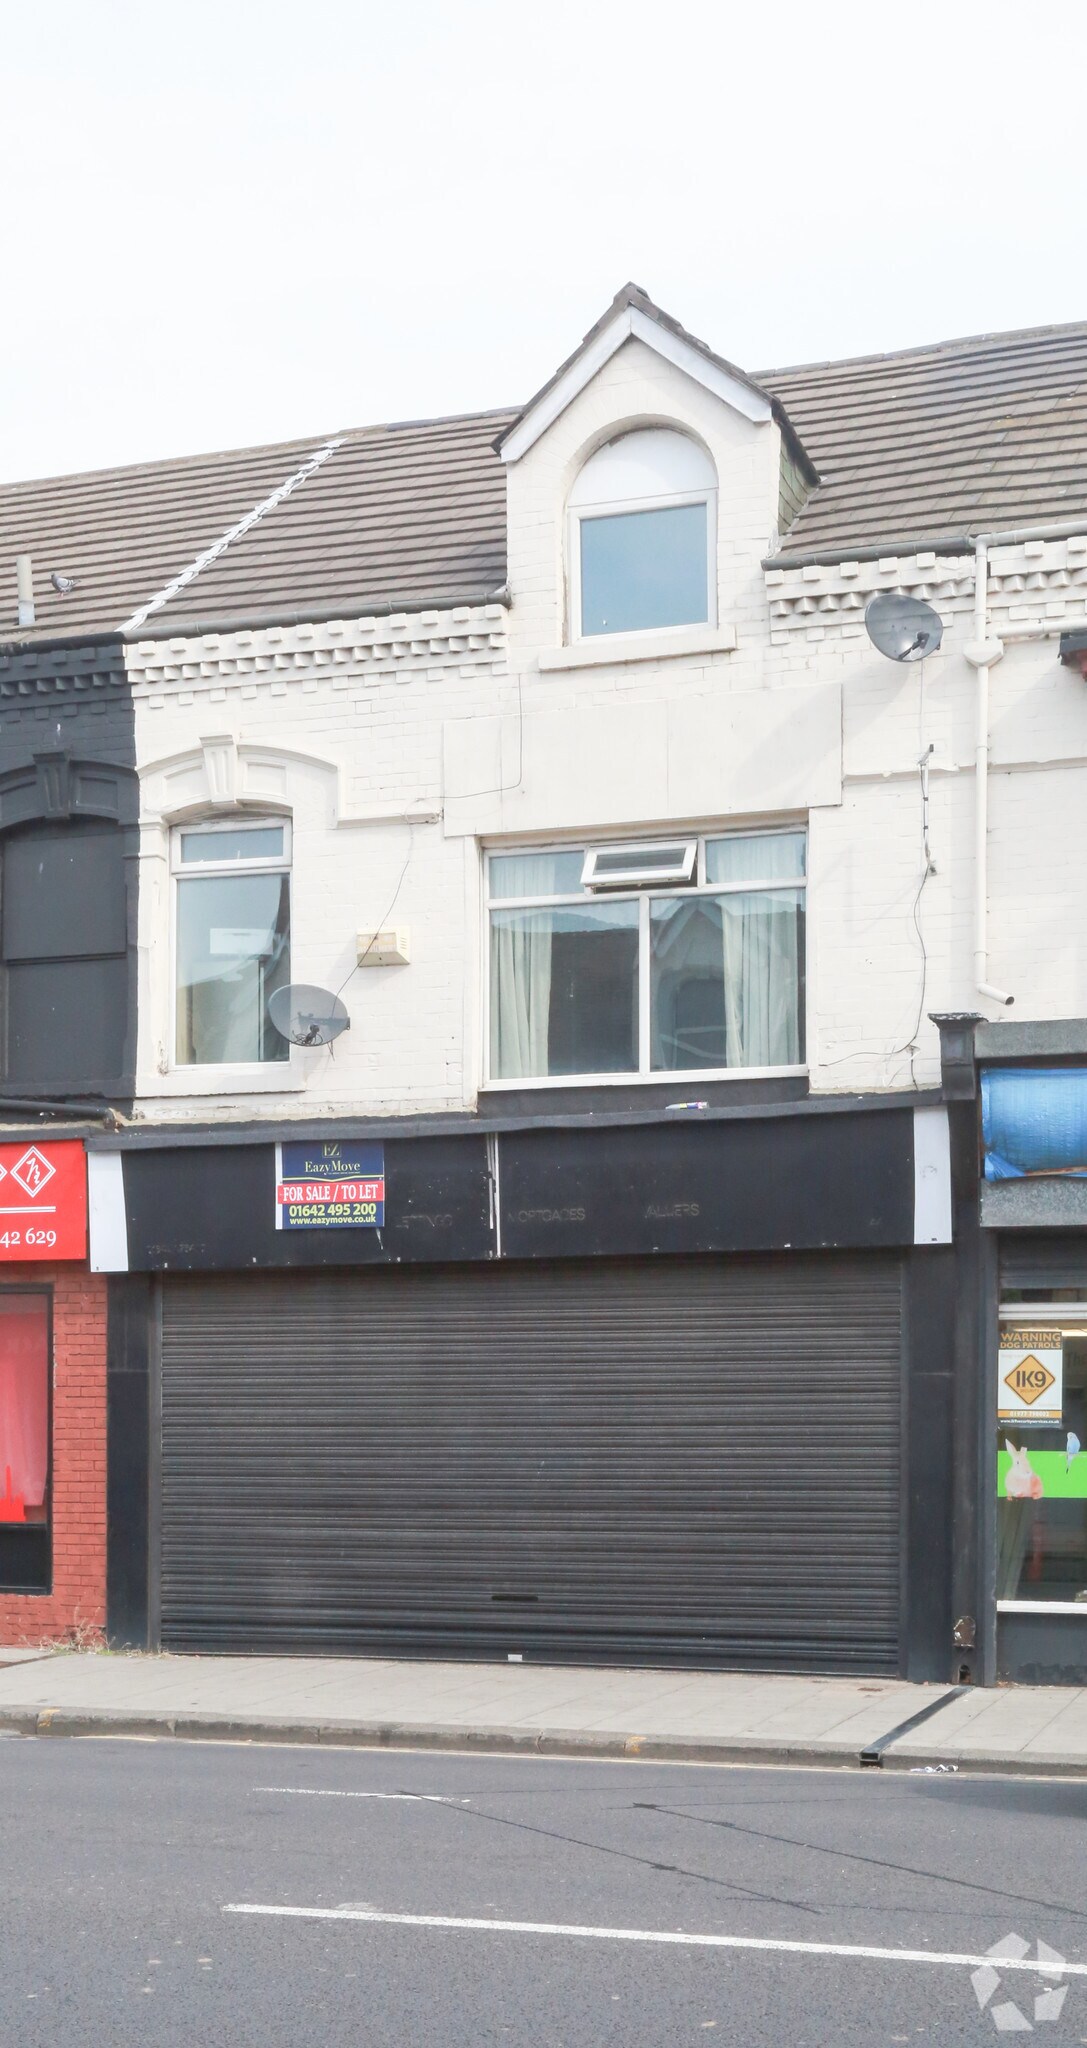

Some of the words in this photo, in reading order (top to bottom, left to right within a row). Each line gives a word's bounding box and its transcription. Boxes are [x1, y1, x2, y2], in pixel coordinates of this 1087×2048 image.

[283, 1186, 304, 1202] FOR
[306, 1185, 331, 1201] SALE
[341, 1184, 357, 1200] TO
[358, 1184, 379, 1199] LET
[288, 1205, 326, 1217] 01642
[327, 1203, 351, 1216] 495
[352, 1202, 377, 1216] 200
[289, 1215, 377, 1226] www.eazymove.co.uk
[25, 1227, 57, 1247] 629
[1001, 1333, 1061, 1341] WARNING
[1000, 1341, 1021, 1349] DOG
[1022, 1341, 1061, 1349] PATROLS
